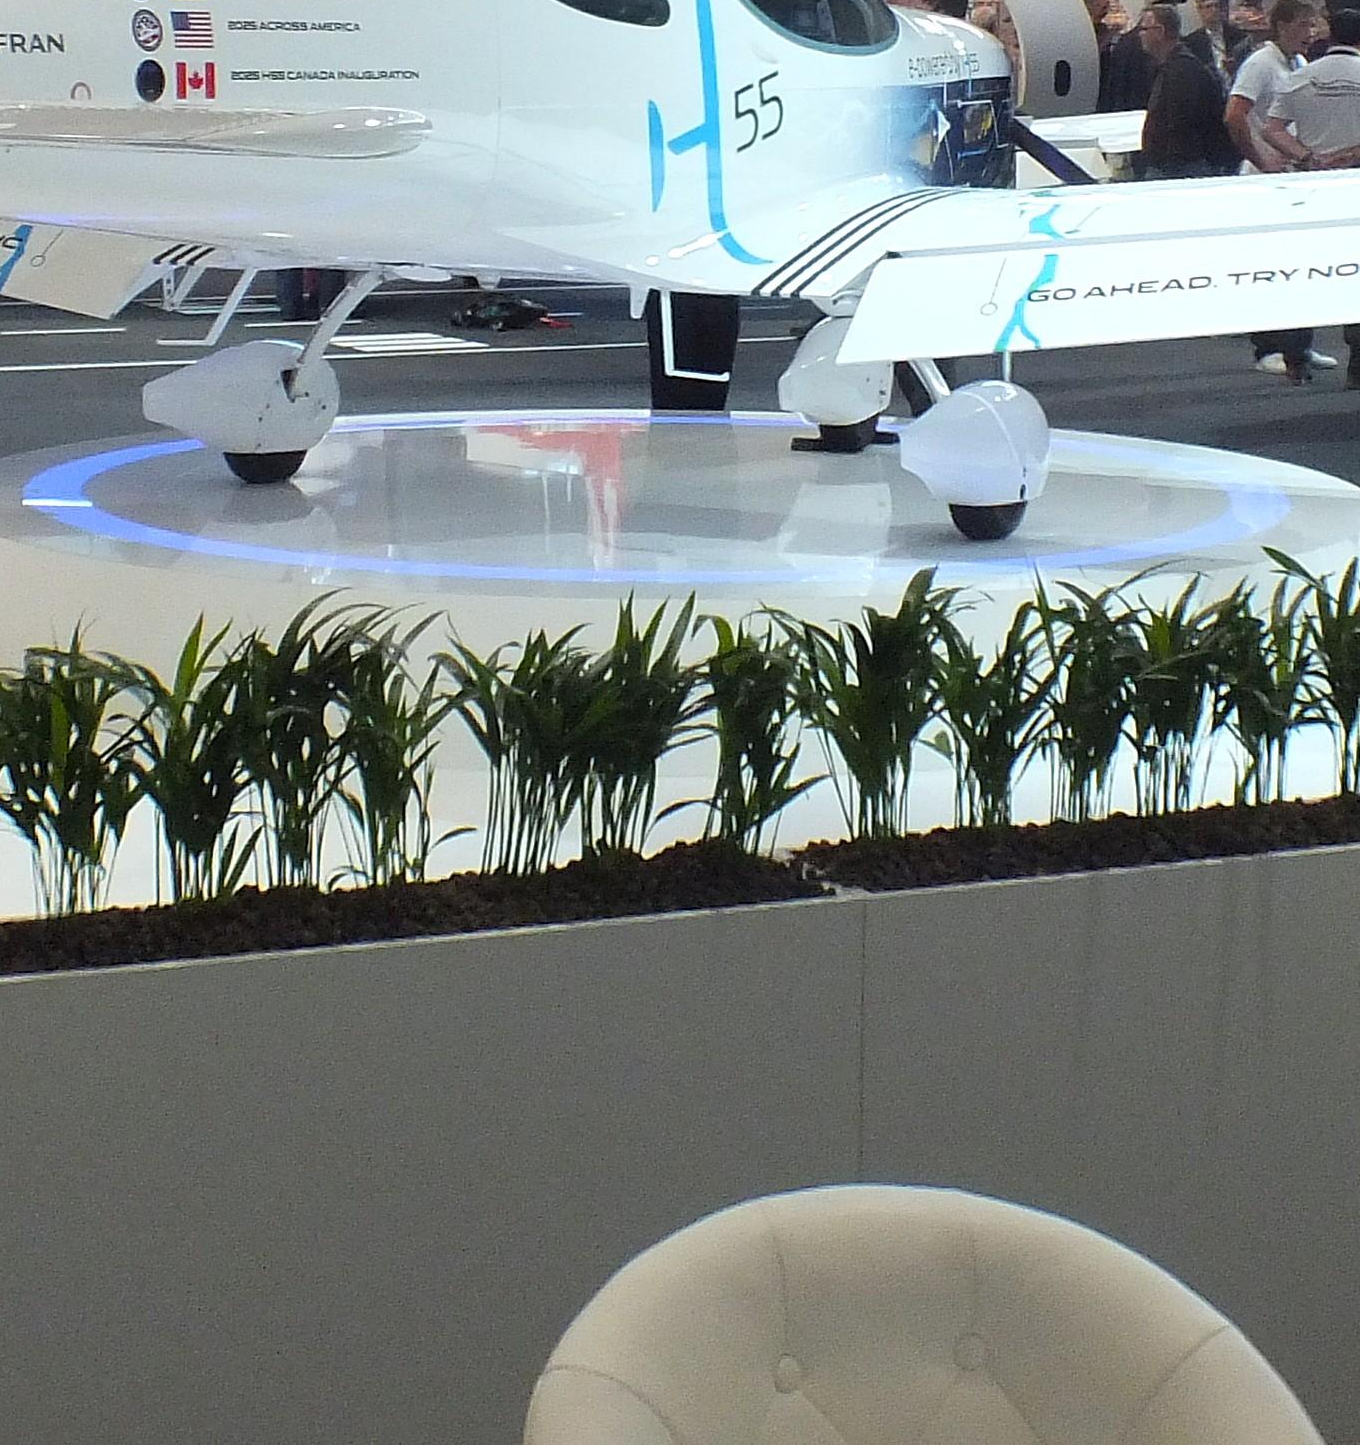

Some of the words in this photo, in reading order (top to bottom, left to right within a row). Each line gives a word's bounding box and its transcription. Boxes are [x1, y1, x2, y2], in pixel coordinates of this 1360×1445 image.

[260, 20, 308, 31] ACROSS
[310, 21, 361, 32] AMERICA
[286, 70, 336, 81] CANADA
[337, 70, 420, 80] INAUGURATION
[1027, 286, 1077, 303] GO
[1083, 275, 1219, 299] AHEAD.
[1227, 268, 1301, 286] TRY
